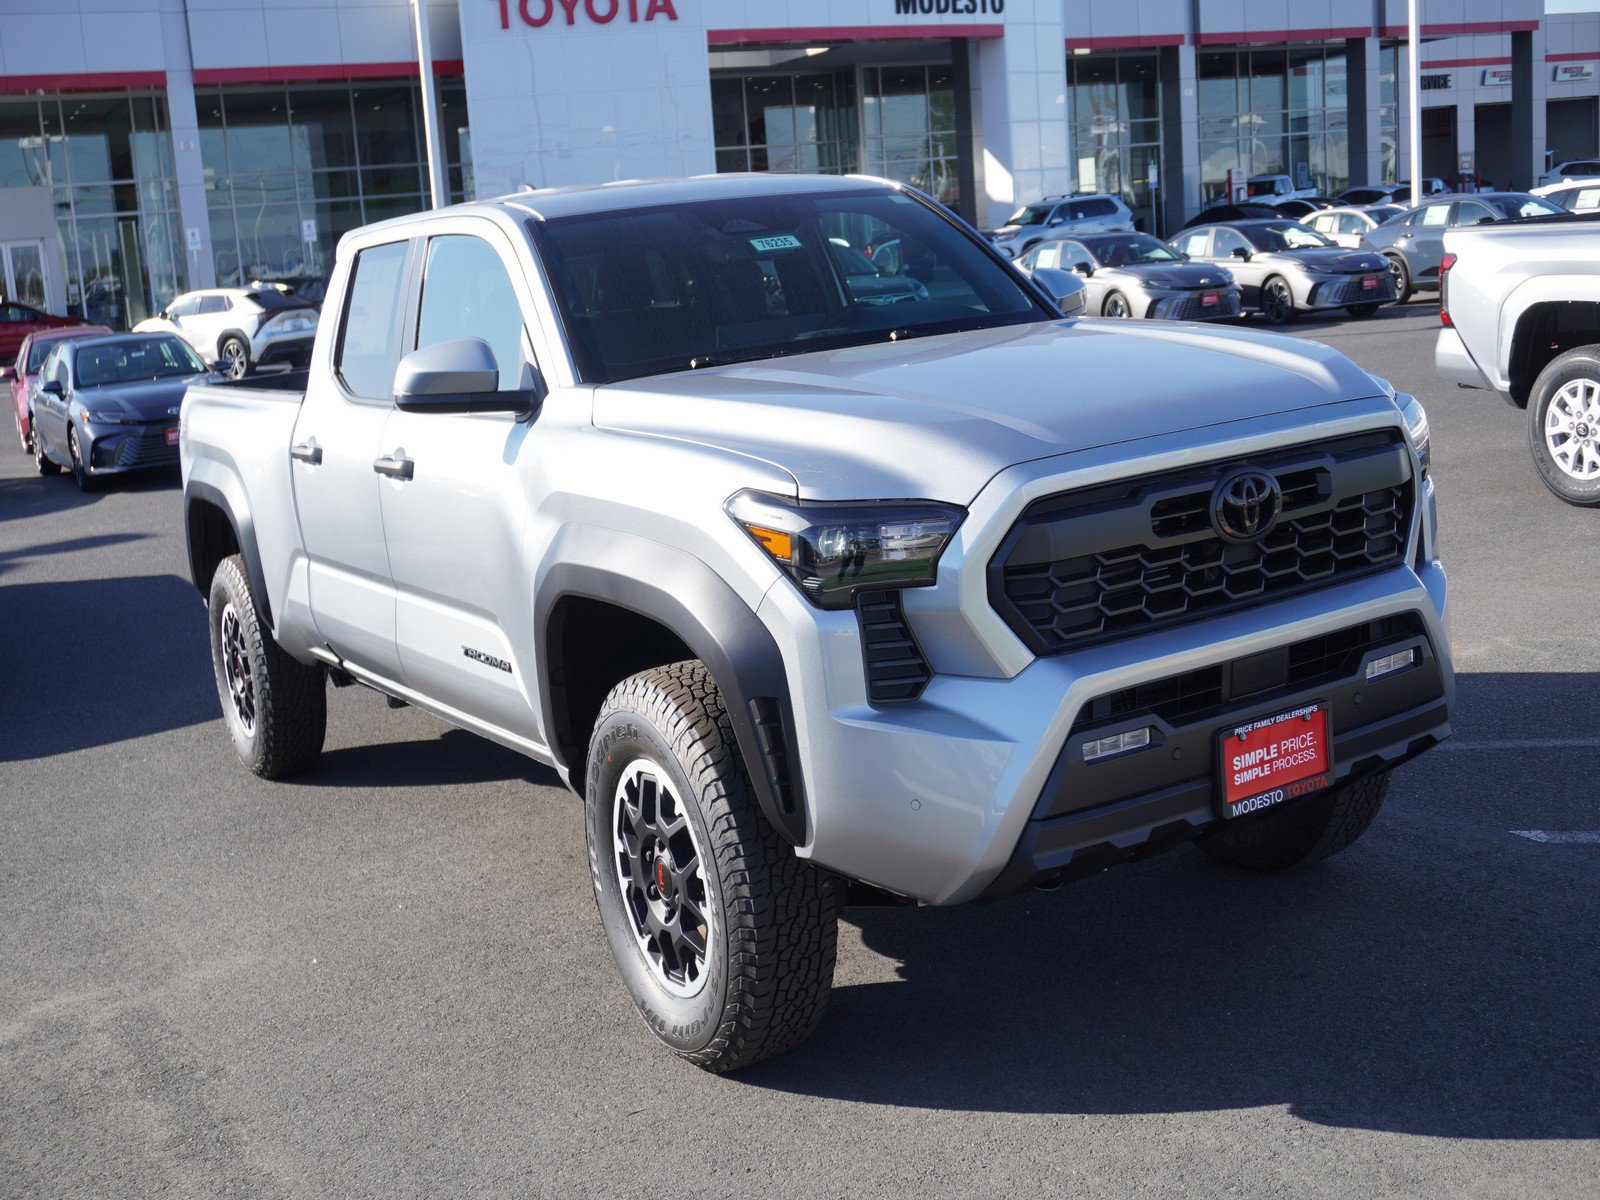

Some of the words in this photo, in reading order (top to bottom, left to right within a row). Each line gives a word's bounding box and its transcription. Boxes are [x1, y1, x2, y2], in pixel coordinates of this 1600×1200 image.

[490, 0, 678, 29] TOYOTA
[895, 0, 1004, 14] MODESTO
[1420, 74, 1452, 90] RVICE
[757, 237, 793, 248] 76235
[462, 645, 512, 674] TACOMA
[1234, 725, 1252, 735] PRICE
[1253, 718, 1275, 730] FAMILY
[1276, 705, 1318, 723] DEALERSHIPS
[1233, 743, 1278, 771] SIMPLE
[1281, 731, 1317, 755] PRICE.
[1234, 764, 1271, 785] SIMPLE
[1272, 748, 1318, 772] PROCESS.
[1232, 789, 1283, 817] MODESTO
[1286, 776, 1328, 799] TOYOTA
